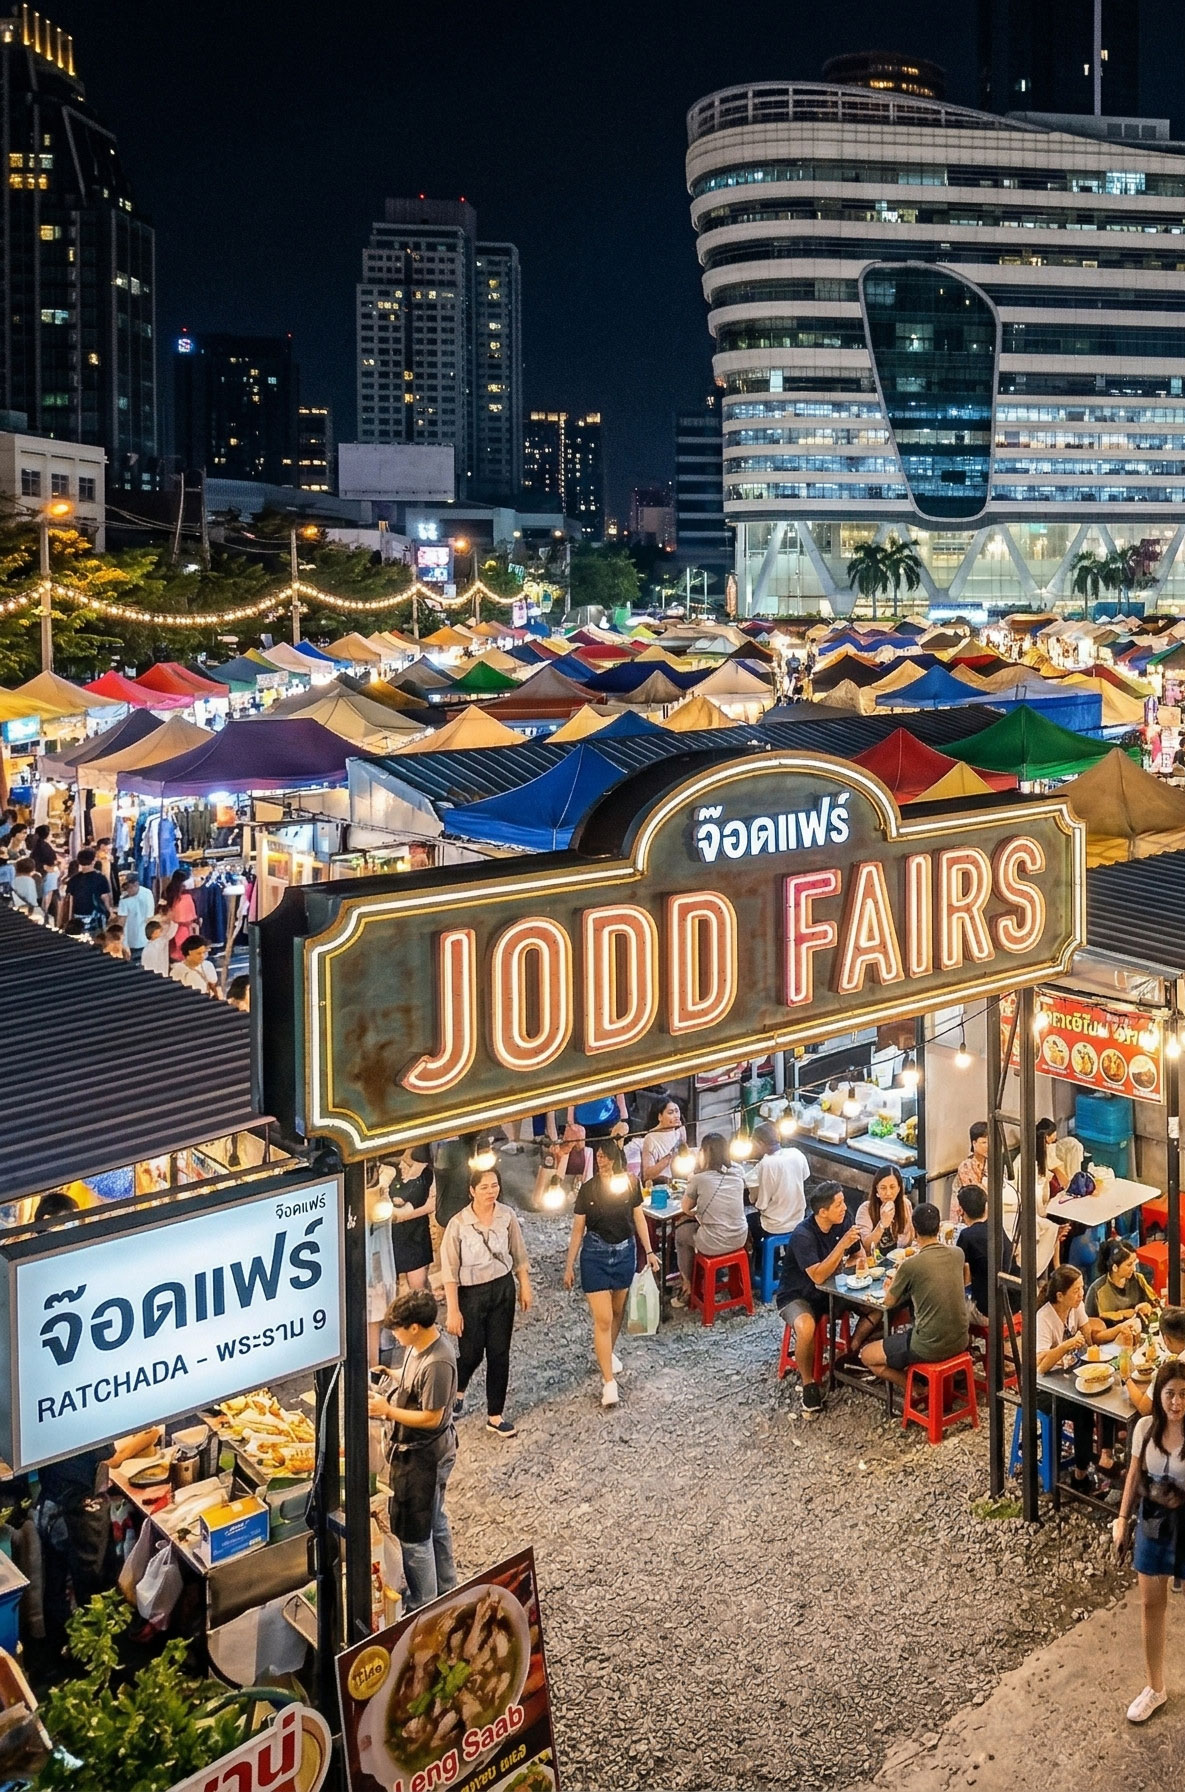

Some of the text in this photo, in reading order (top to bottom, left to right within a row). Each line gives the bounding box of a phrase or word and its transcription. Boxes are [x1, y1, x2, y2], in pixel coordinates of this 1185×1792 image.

[697, 792, 850, 863] จ๊อดแฟร์
[402, 836, 1046, 1094] JODD FAIRS
[39, 1216, 324, 1366] จ๊อดแฟร์
[37, 1354, 189, 1423] RATCHADA
[216, 1316, 305, 1362] พระราม
[313, 1309, 327, 1331] 9
[464, 1704, 524, 1758] Saab
